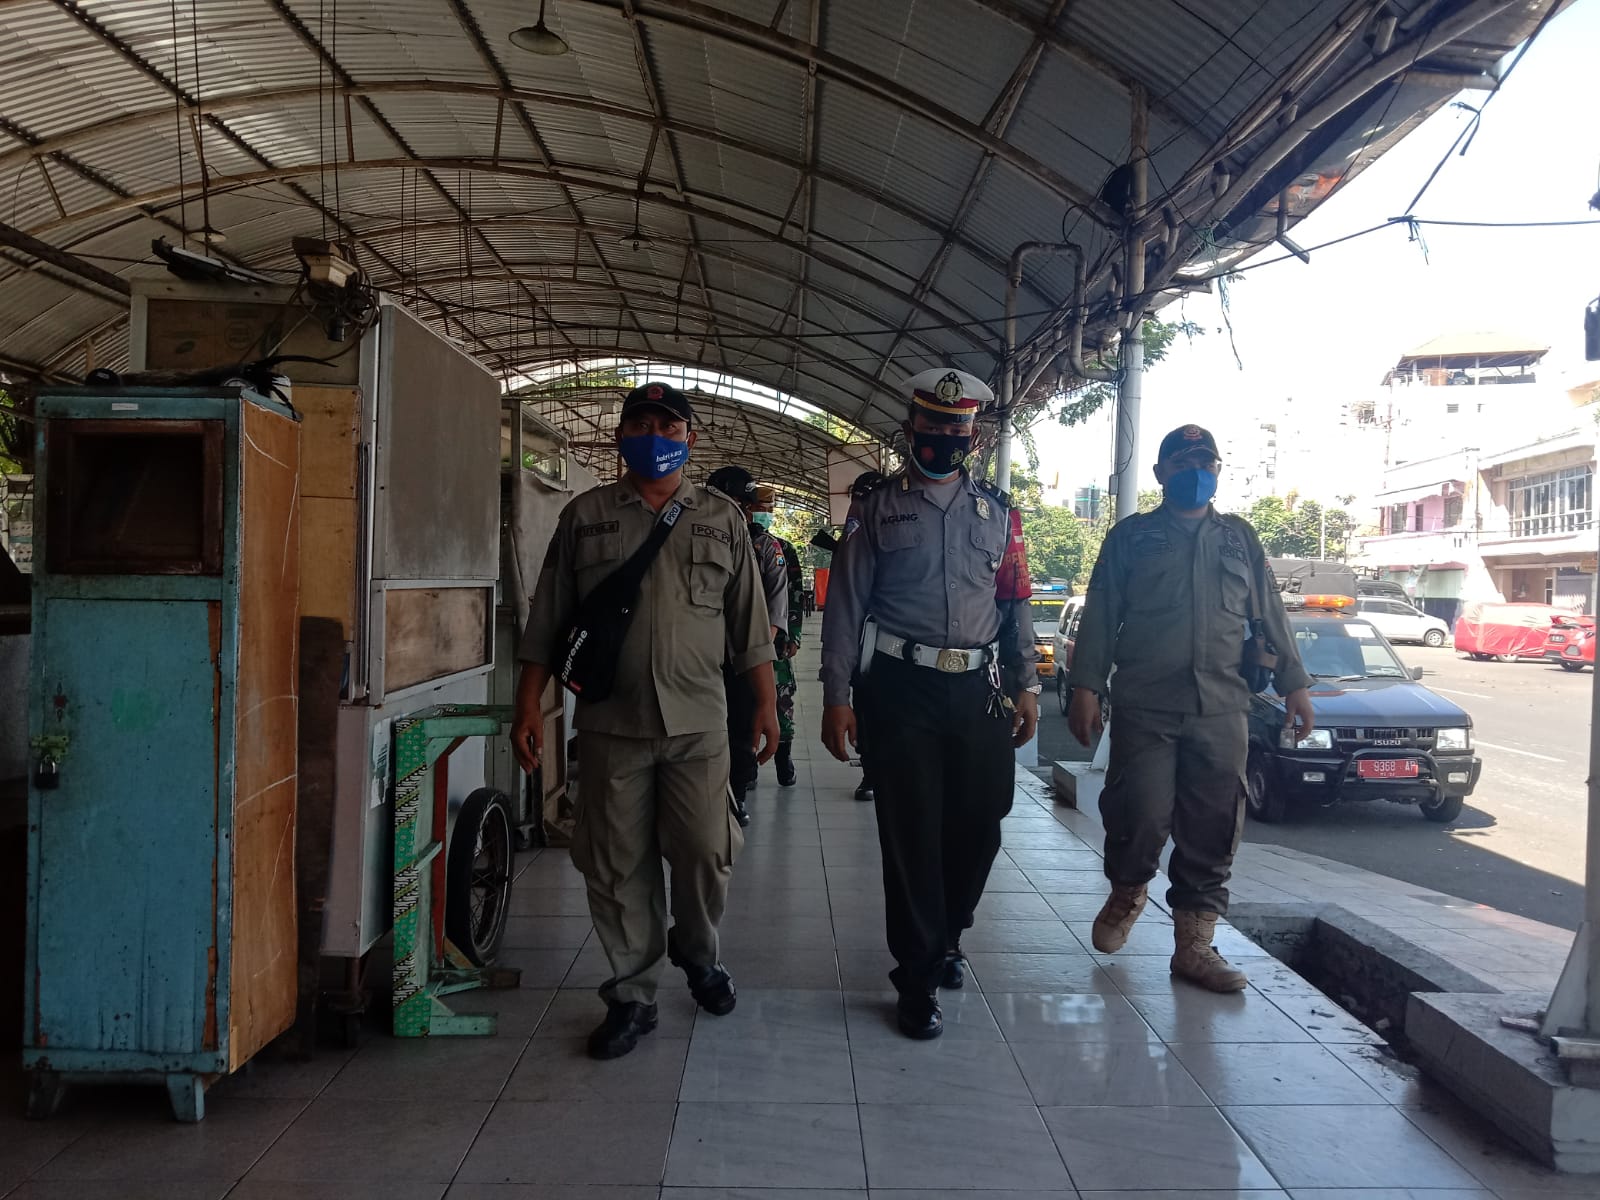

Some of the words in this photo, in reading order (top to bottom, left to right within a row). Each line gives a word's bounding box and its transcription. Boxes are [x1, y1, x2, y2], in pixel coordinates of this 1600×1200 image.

[666, 506, 678, 523] PRO
[880, 513, 918, 526] AGUNG
[697, 526, 718, 538] POL
[1360, 762, 1365, 772] L
[1374, 762, 1395, 772] 9368
[1405, 761, 1416, 772] AP
